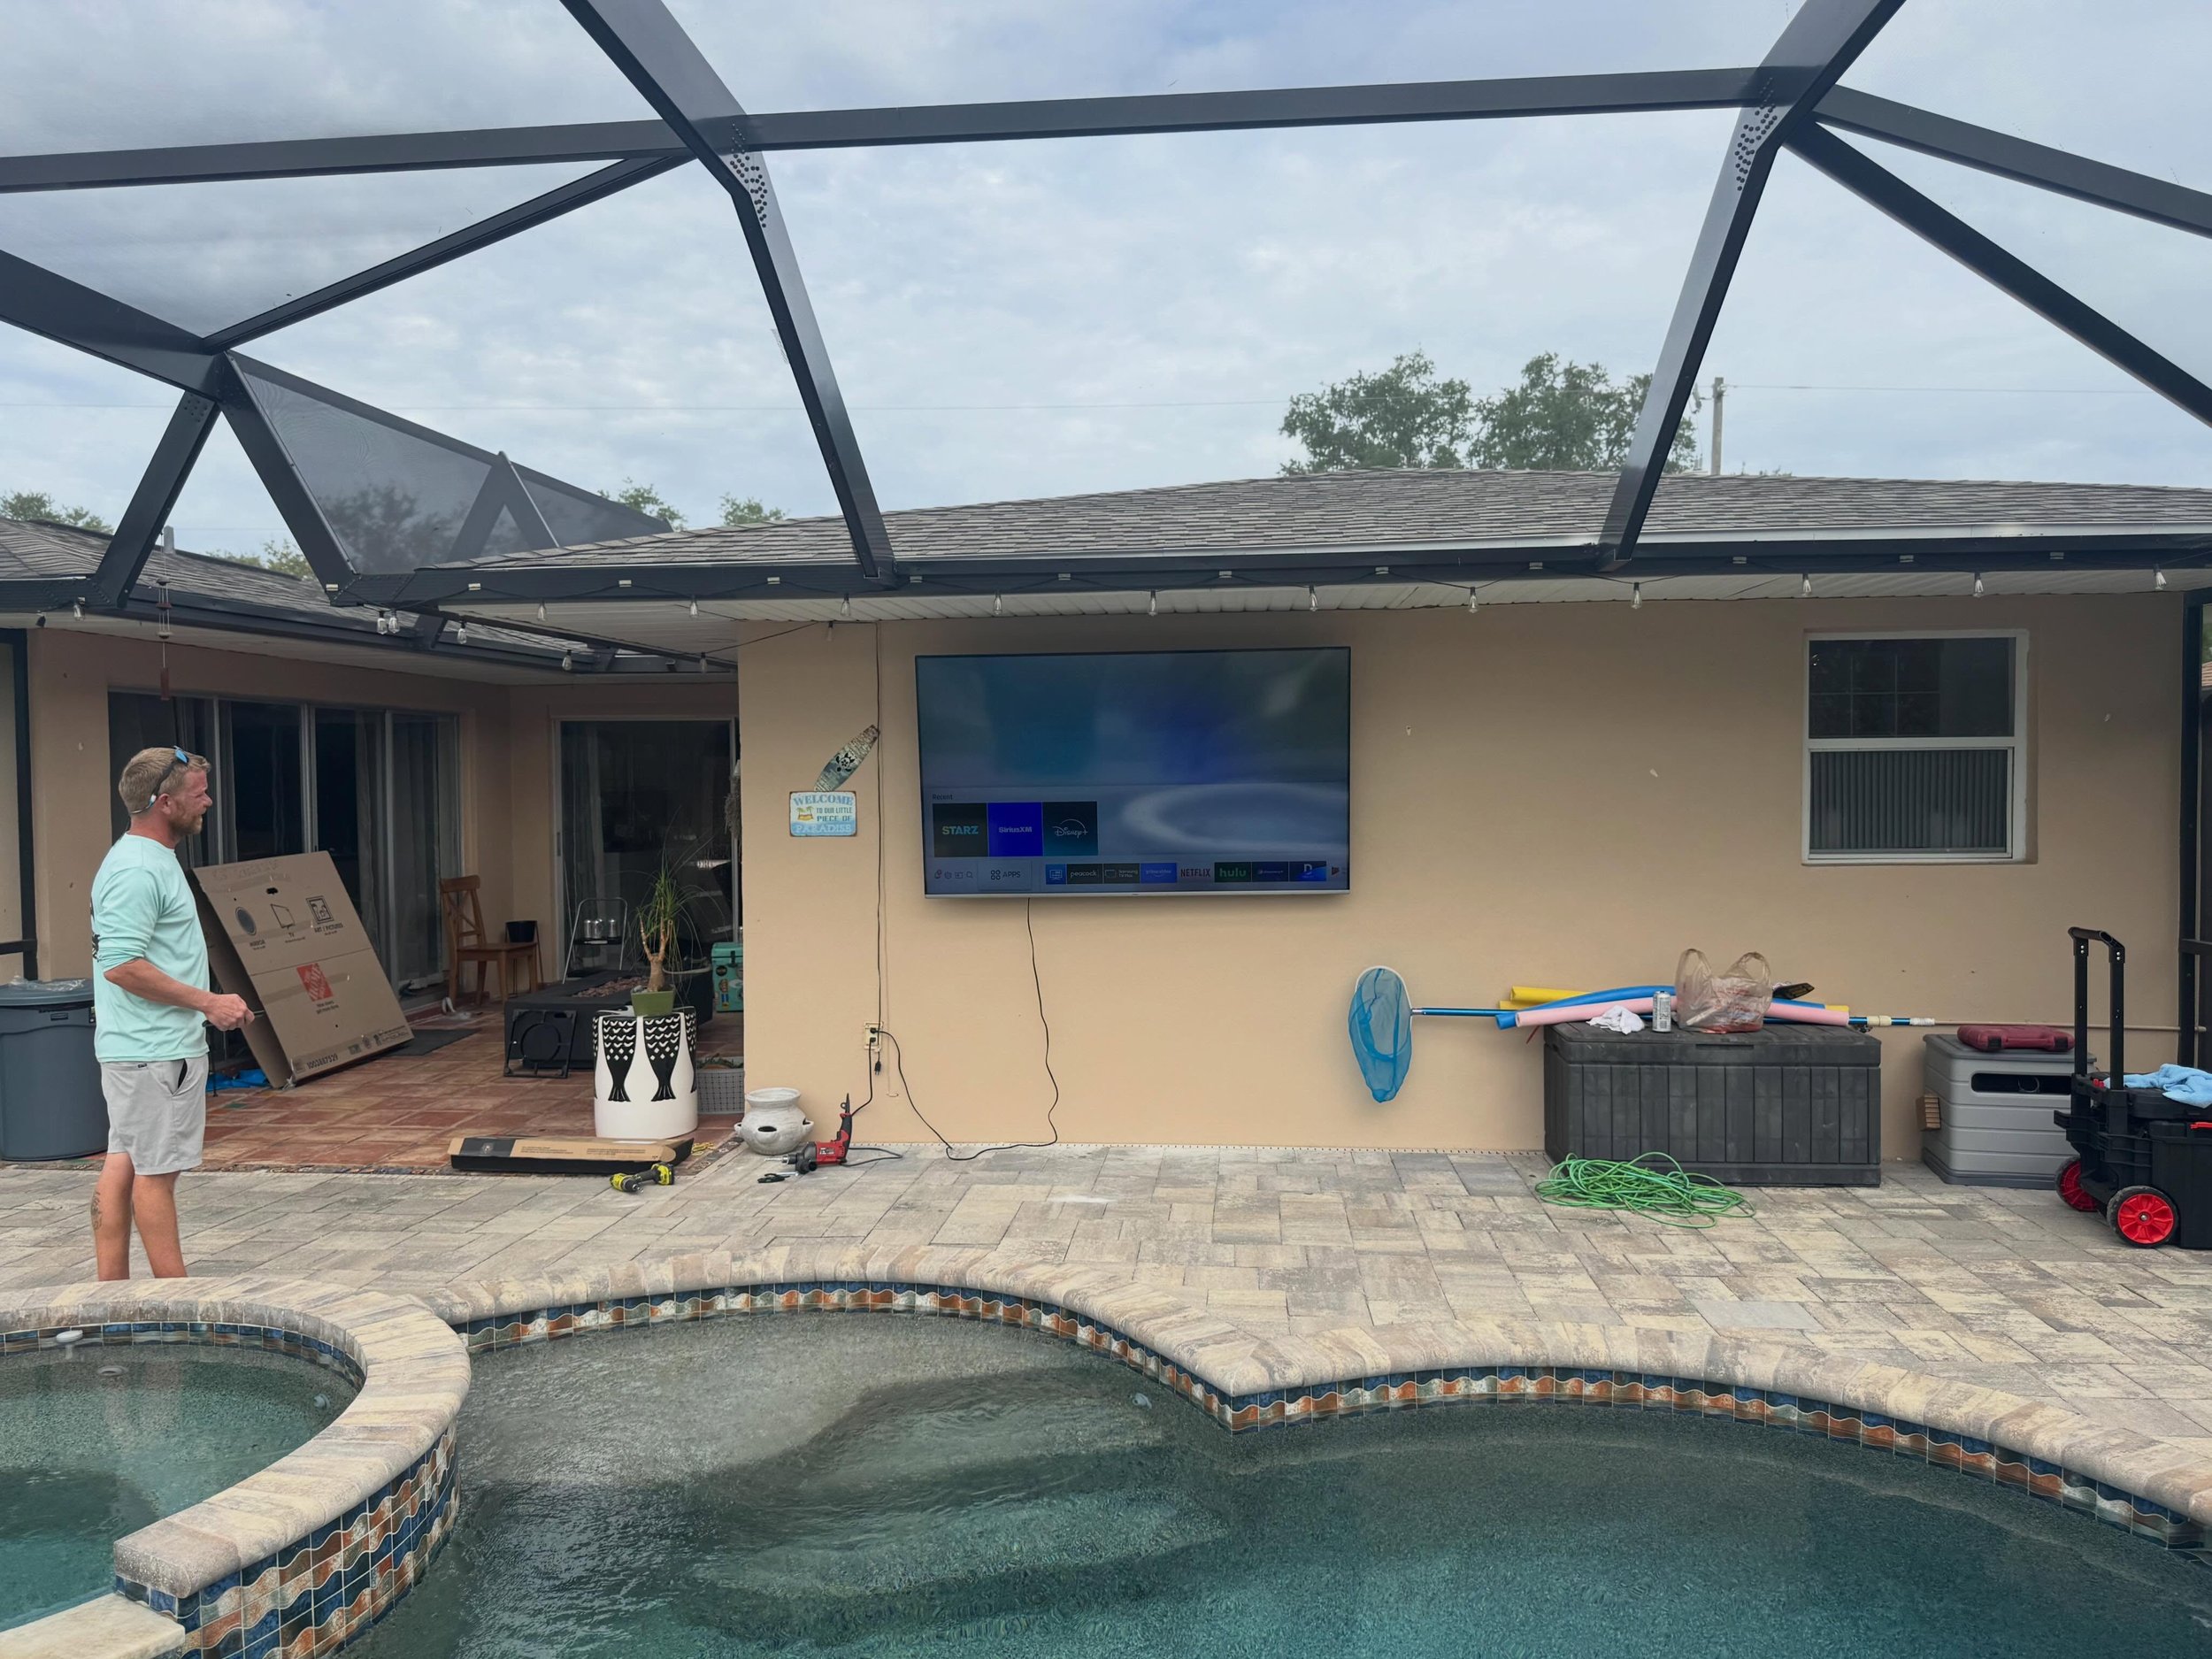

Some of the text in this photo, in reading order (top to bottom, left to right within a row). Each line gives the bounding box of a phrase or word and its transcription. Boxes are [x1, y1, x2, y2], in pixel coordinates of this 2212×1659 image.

[793, 795, 854, 806] WELCOME
[795, 824, 851, 833] PARADISE
[941, 826, 979, 835] STARZ
[1070, 870, 1097, 879] peacock
[1180, 868, 1210, 877] NETFLIX
[1219, 867, 1247, 878] hulu
